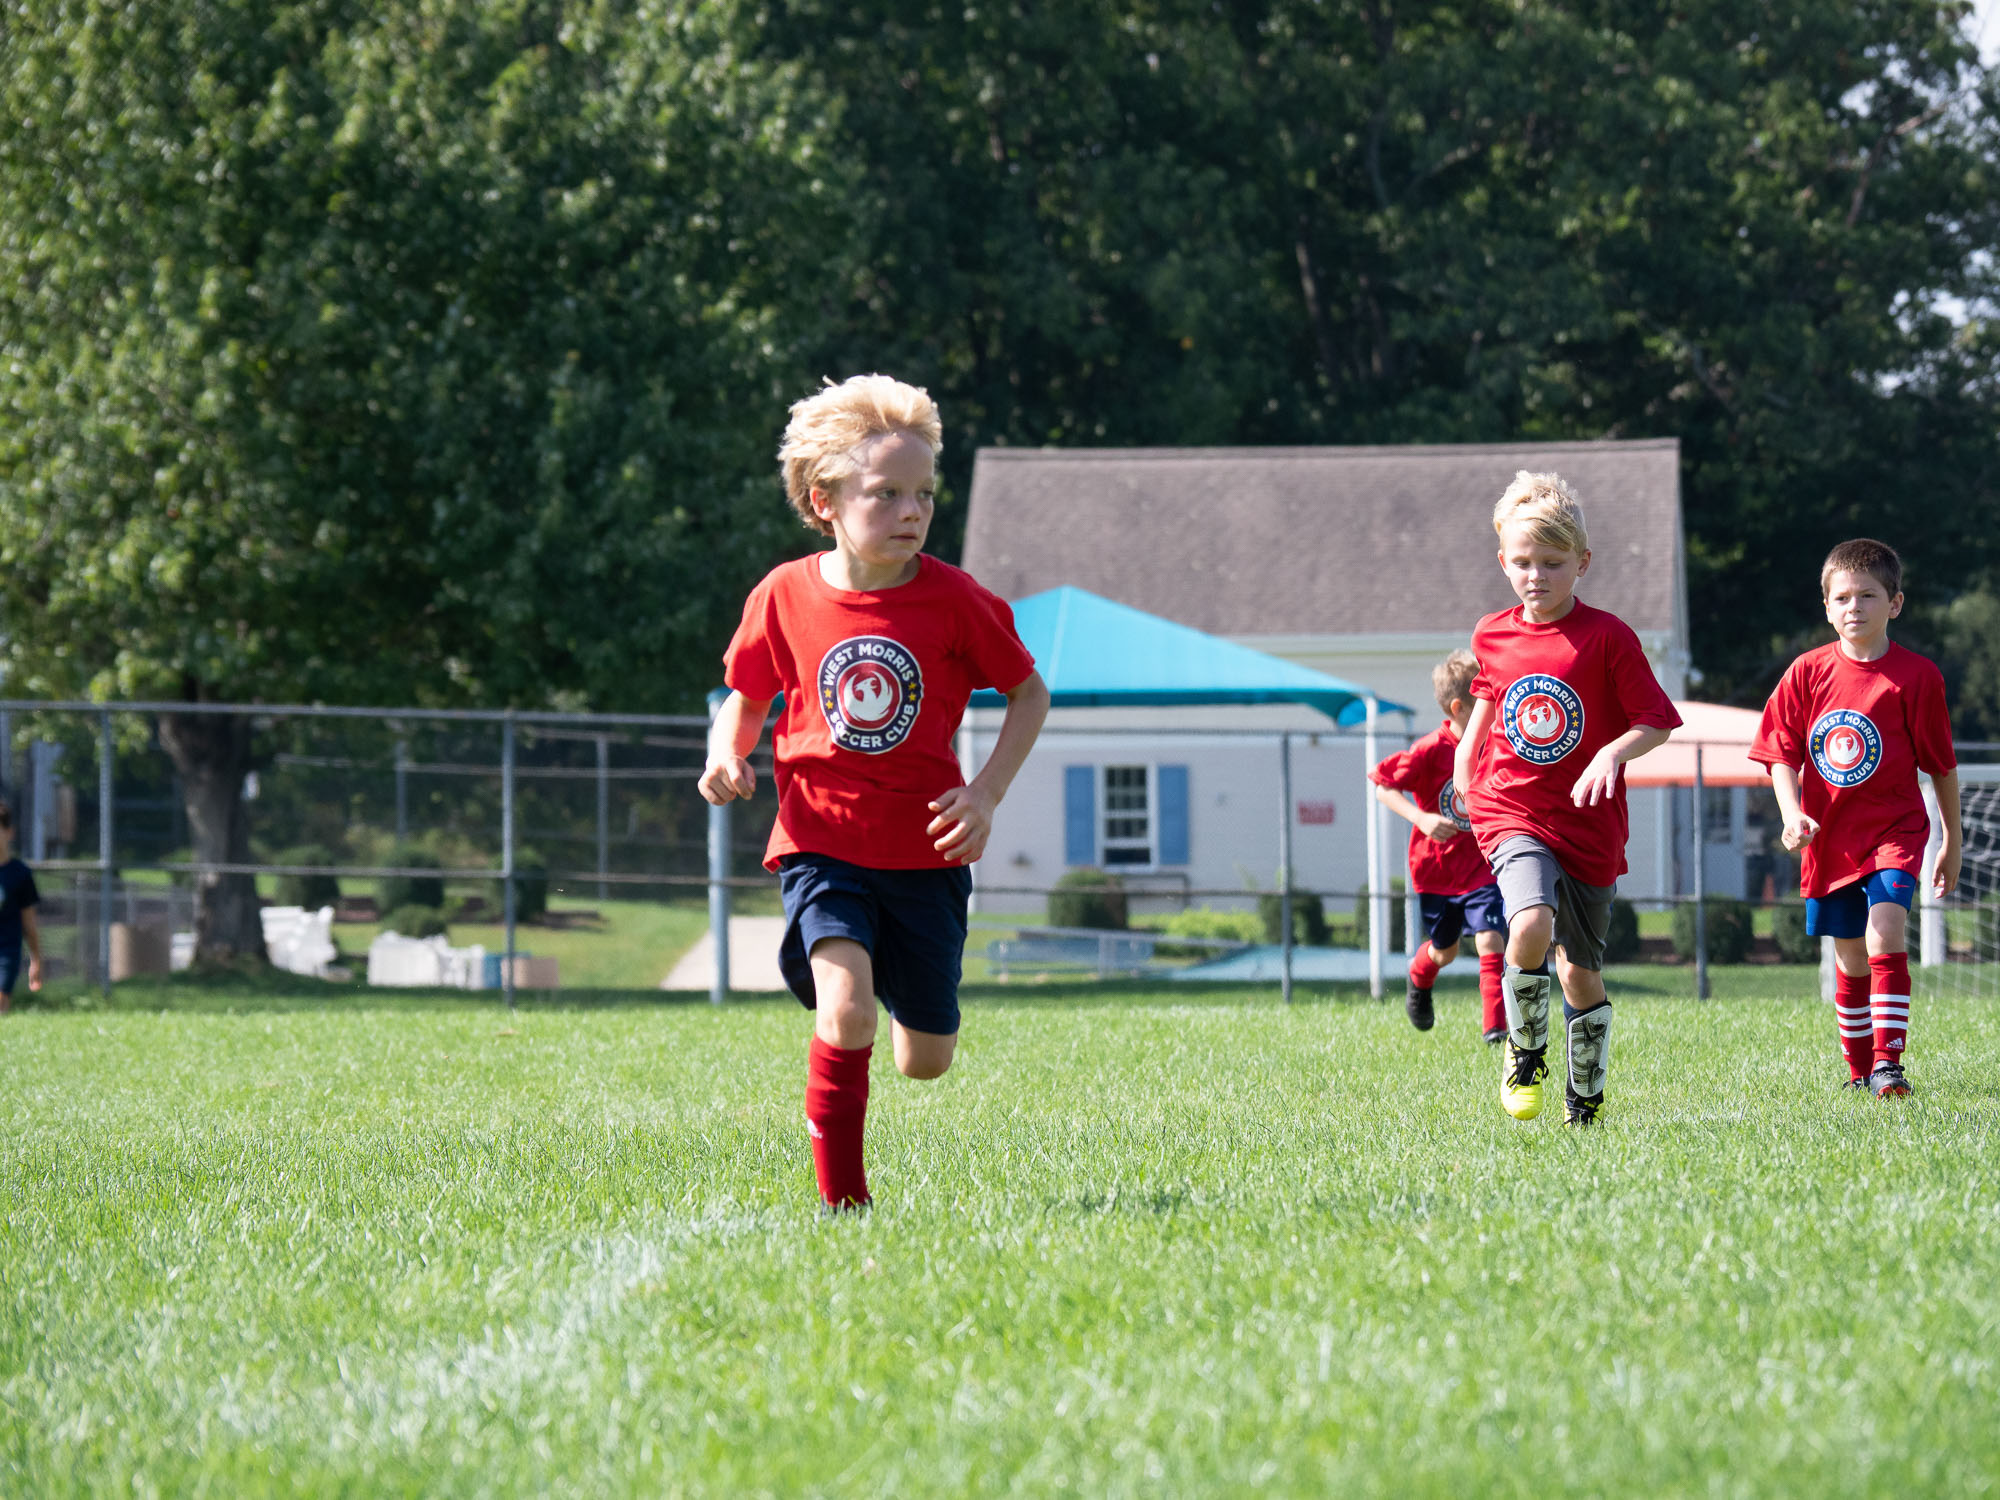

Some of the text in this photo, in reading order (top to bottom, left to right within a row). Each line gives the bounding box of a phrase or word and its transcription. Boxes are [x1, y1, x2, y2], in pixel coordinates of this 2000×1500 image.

[823, 643, 914, 686] WEST MORRIS
[1506, 680, 1577, 711] WEST MORRIS
[830, 704, 914, 748] SOCCER CLUB
[1815, 712, 1877, 746] WEST MORRIS
[1508, 729, 1578, 760] SOCCER CLUB
[1815, 752, 1873, 784] SOCCER CLUB
